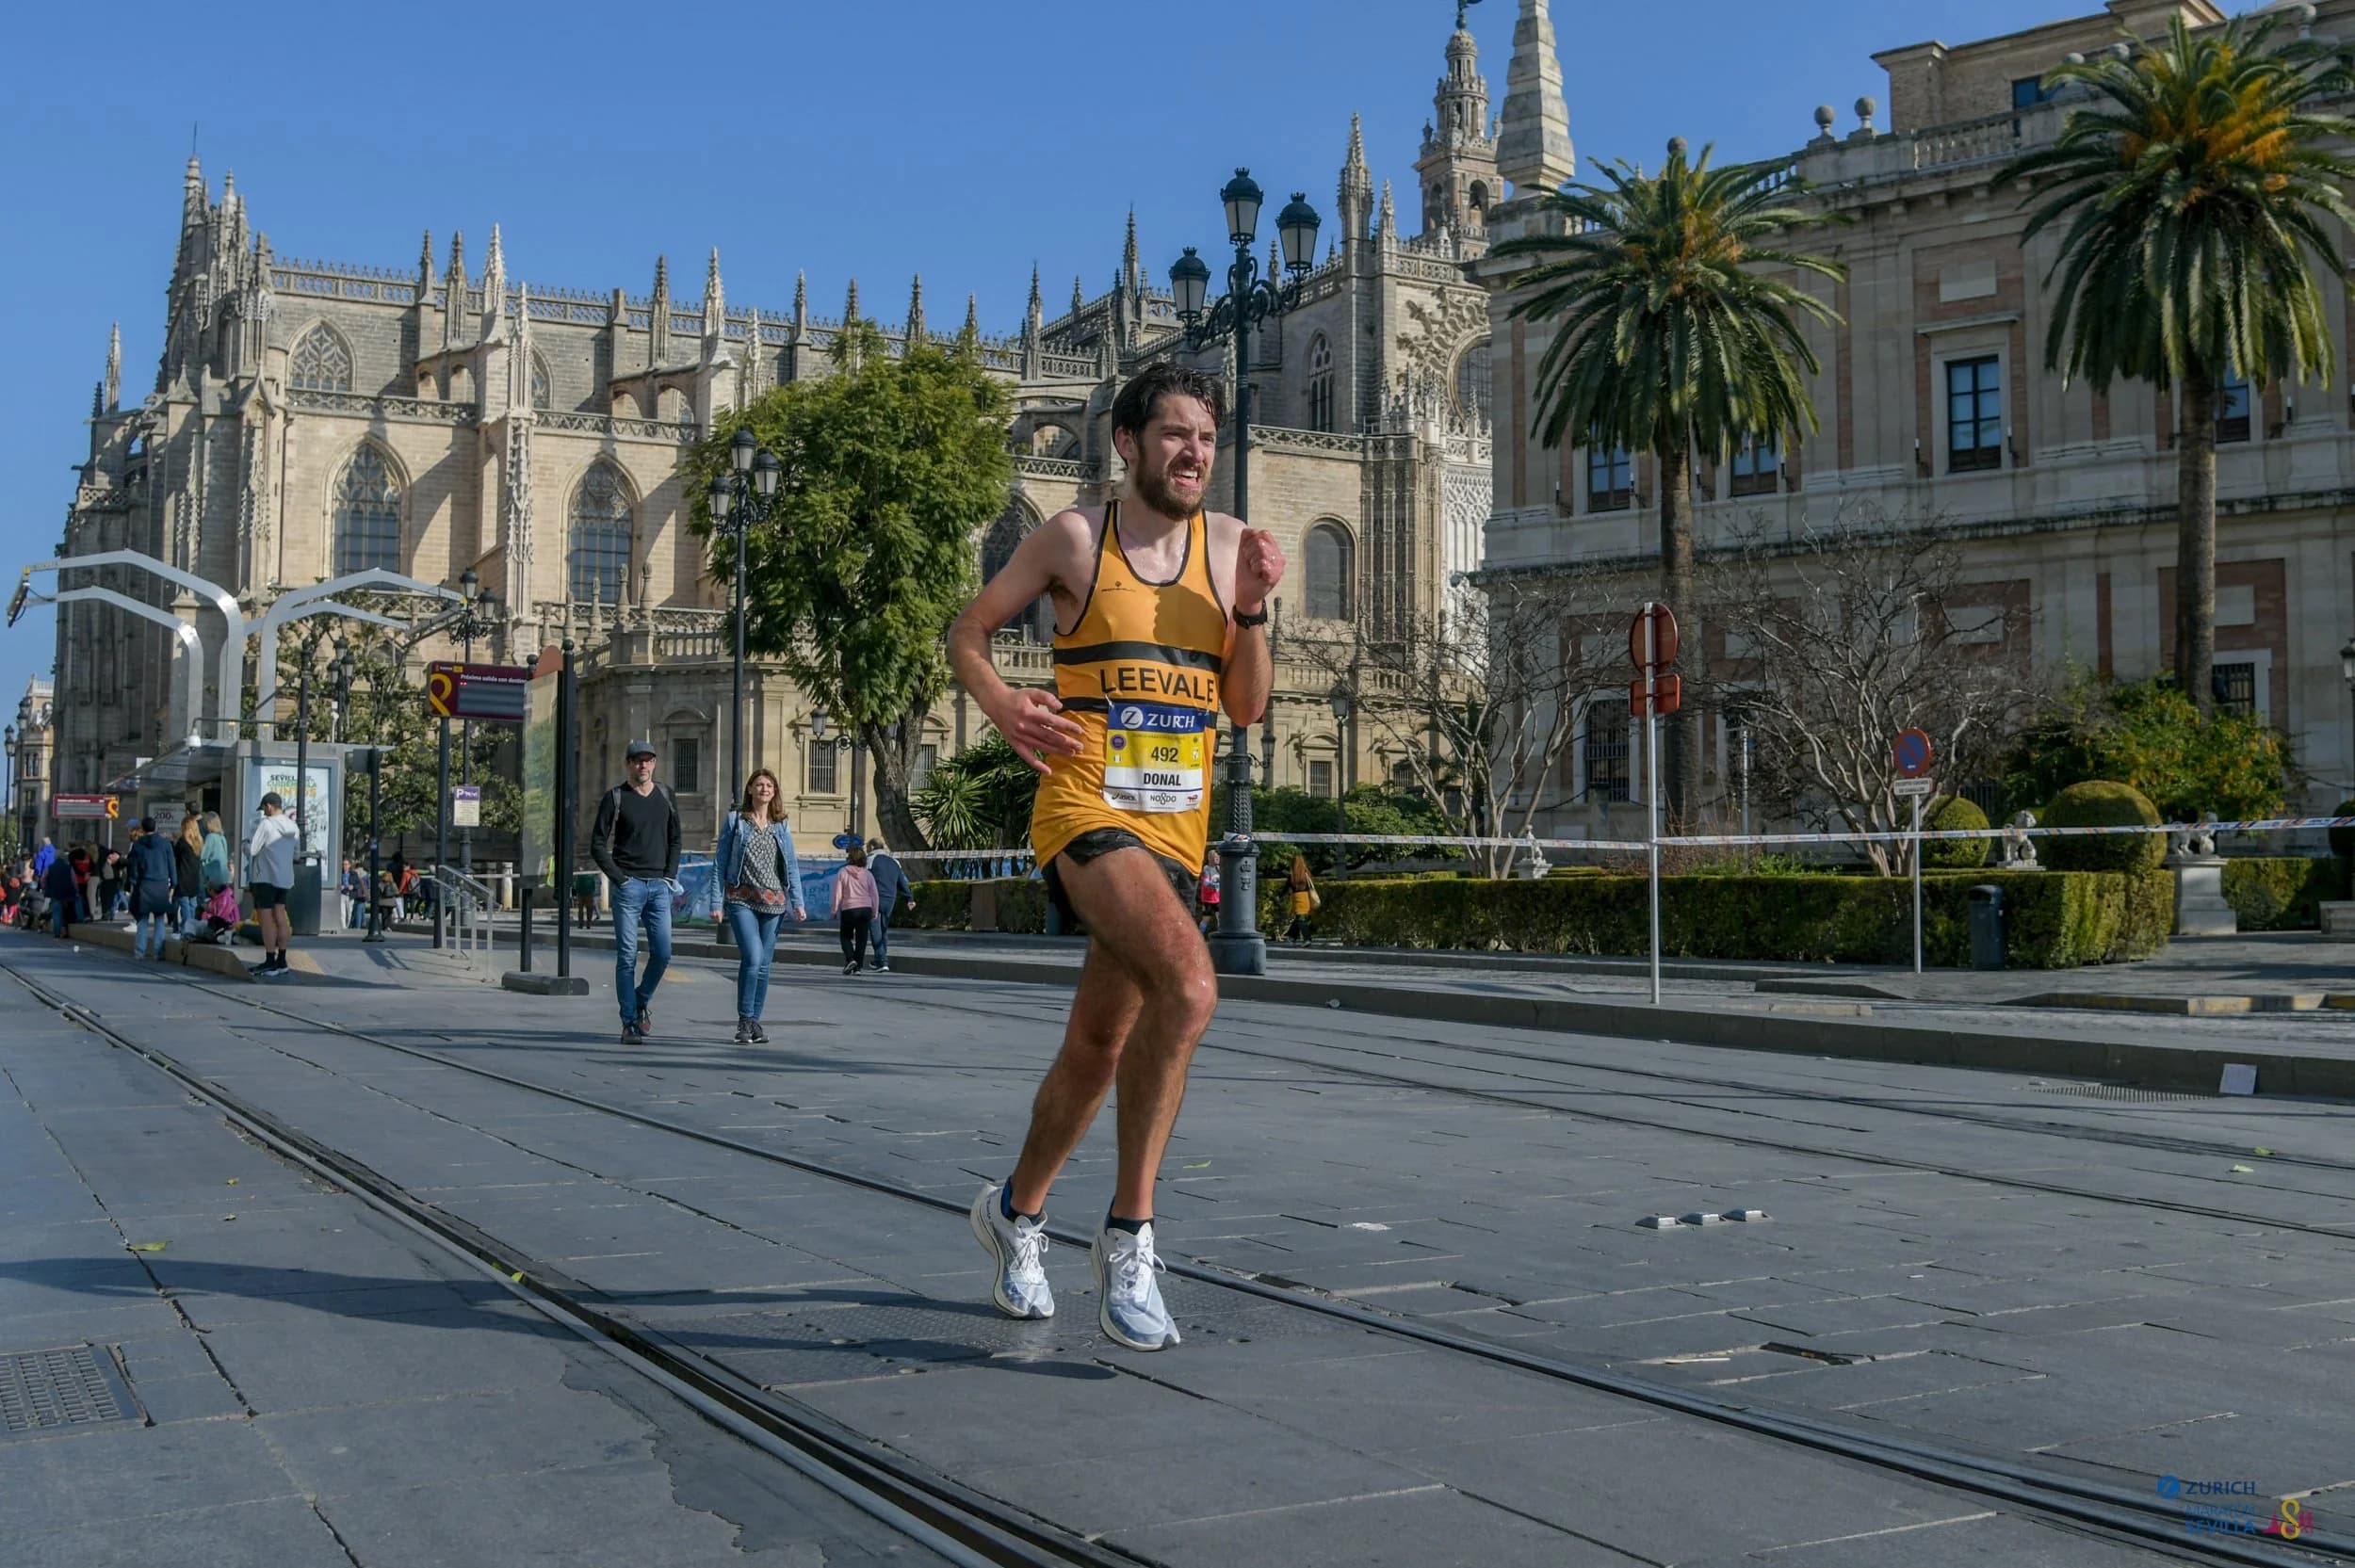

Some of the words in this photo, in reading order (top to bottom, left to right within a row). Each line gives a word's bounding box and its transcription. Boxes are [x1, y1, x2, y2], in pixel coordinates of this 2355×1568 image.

[1100, 667, 1213, 703] LEEVALE
[1146, 713, 1194, 728] ZURCH
[1151, 747, 1178, 762] 492
[1143, 772, 1181, 786] DONAL
